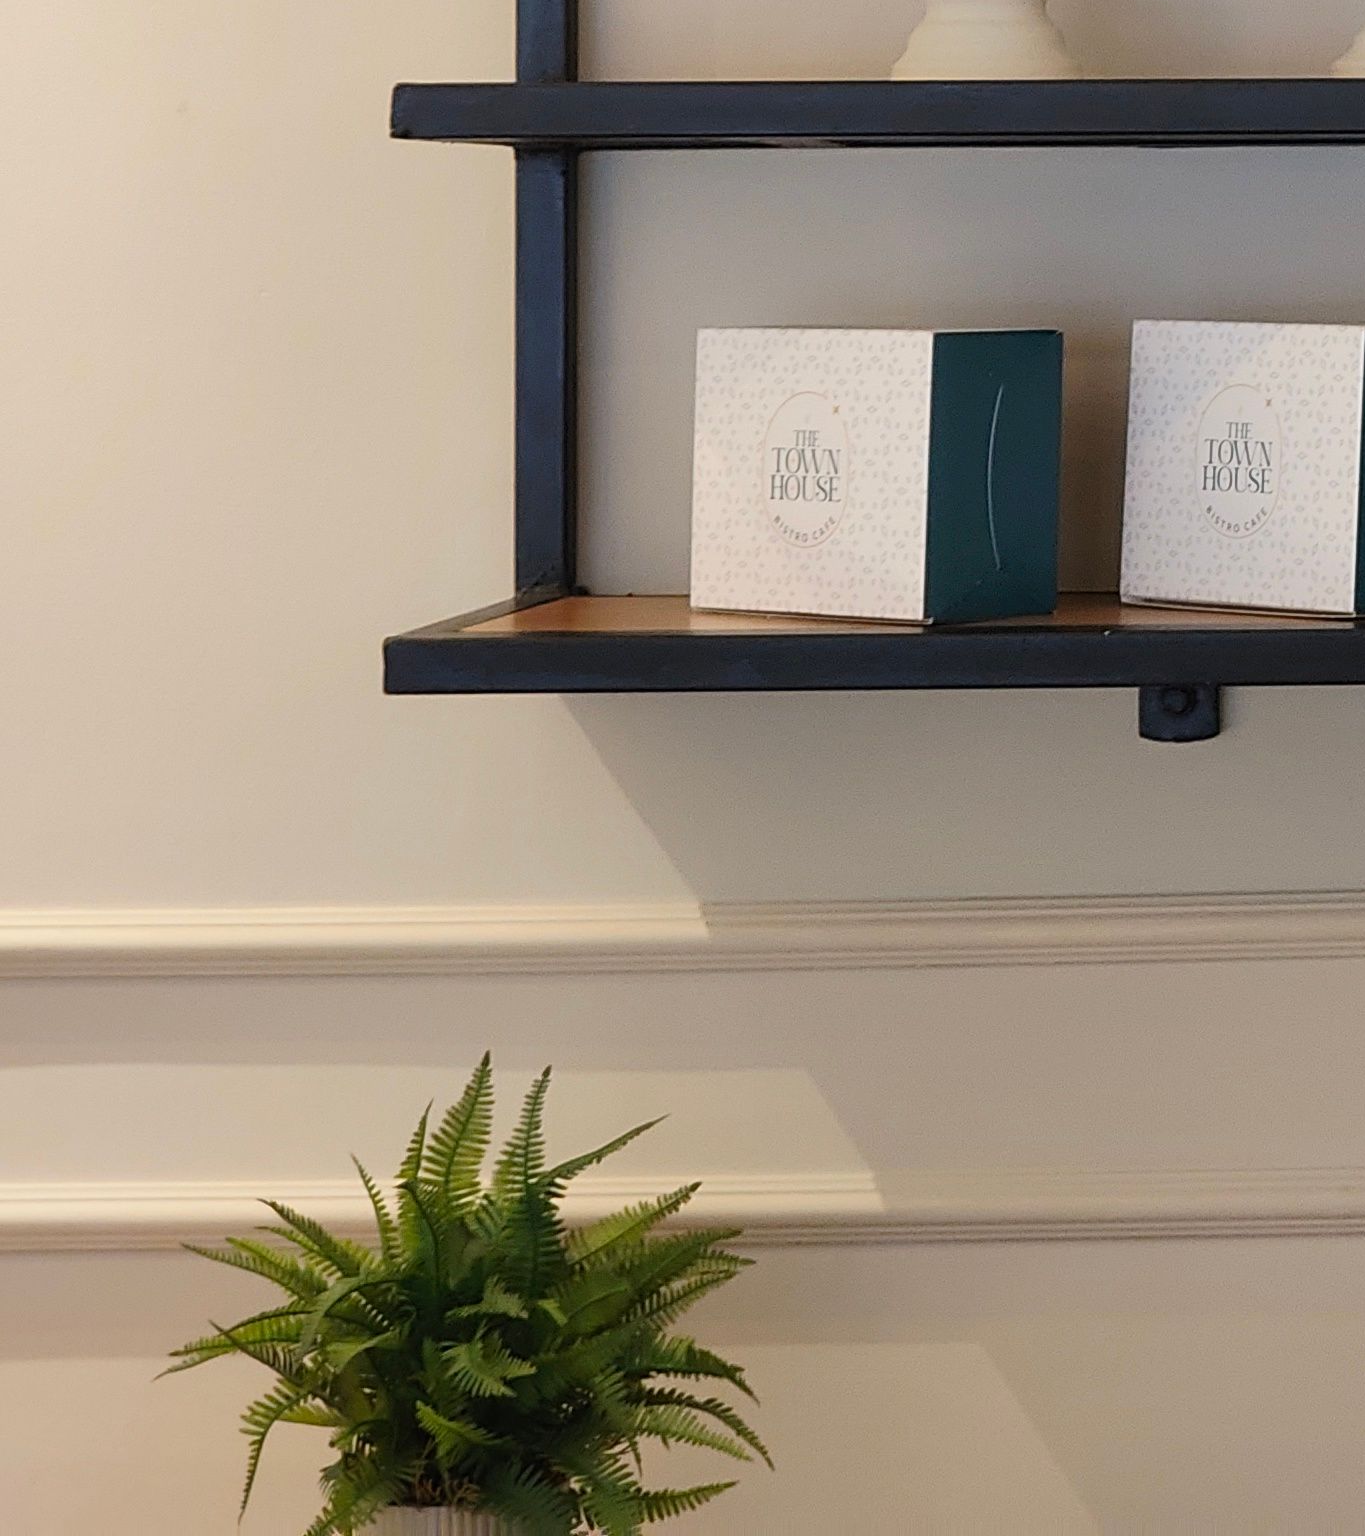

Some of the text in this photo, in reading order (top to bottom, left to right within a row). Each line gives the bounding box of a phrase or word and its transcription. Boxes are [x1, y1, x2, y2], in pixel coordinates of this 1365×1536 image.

[793, 430, 820, 447] THE
[1226, 422, 1253, 439] THE
[771, 448, 842, 474] TOWN
[1204, 439, 1274, 466] TOWN
[770, 474, 842, 502] HOUSE
[1202, 466, 1273, 494] HOUSE
[1206, 506, 1241, 533] BISTRO
